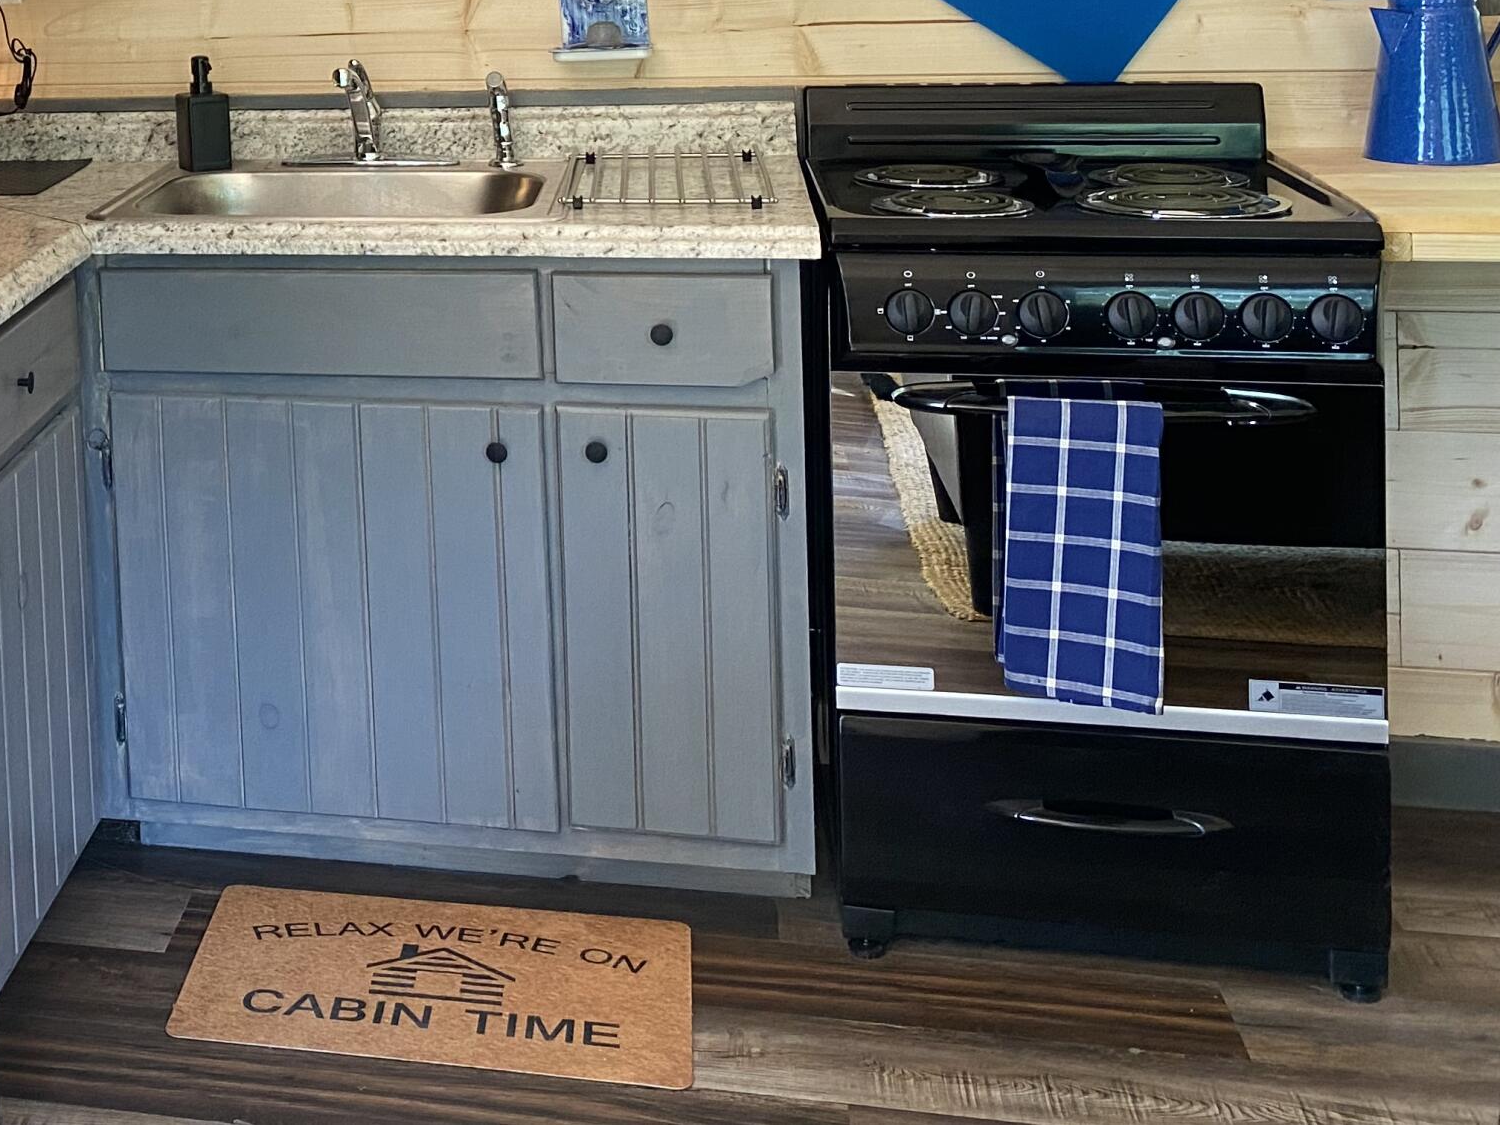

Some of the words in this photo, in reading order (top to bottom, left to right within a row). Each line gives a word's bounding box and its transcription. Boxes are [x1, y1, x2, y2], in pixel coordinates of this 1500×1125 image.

[252, 921, 394, 940] RELAX
[414, 923, 562, 956] WE'RE
[579, 948, 648, 974] ON
[243, 989, 432, 1029] CABIN
[466, 1009, 621, 1049] TIME
